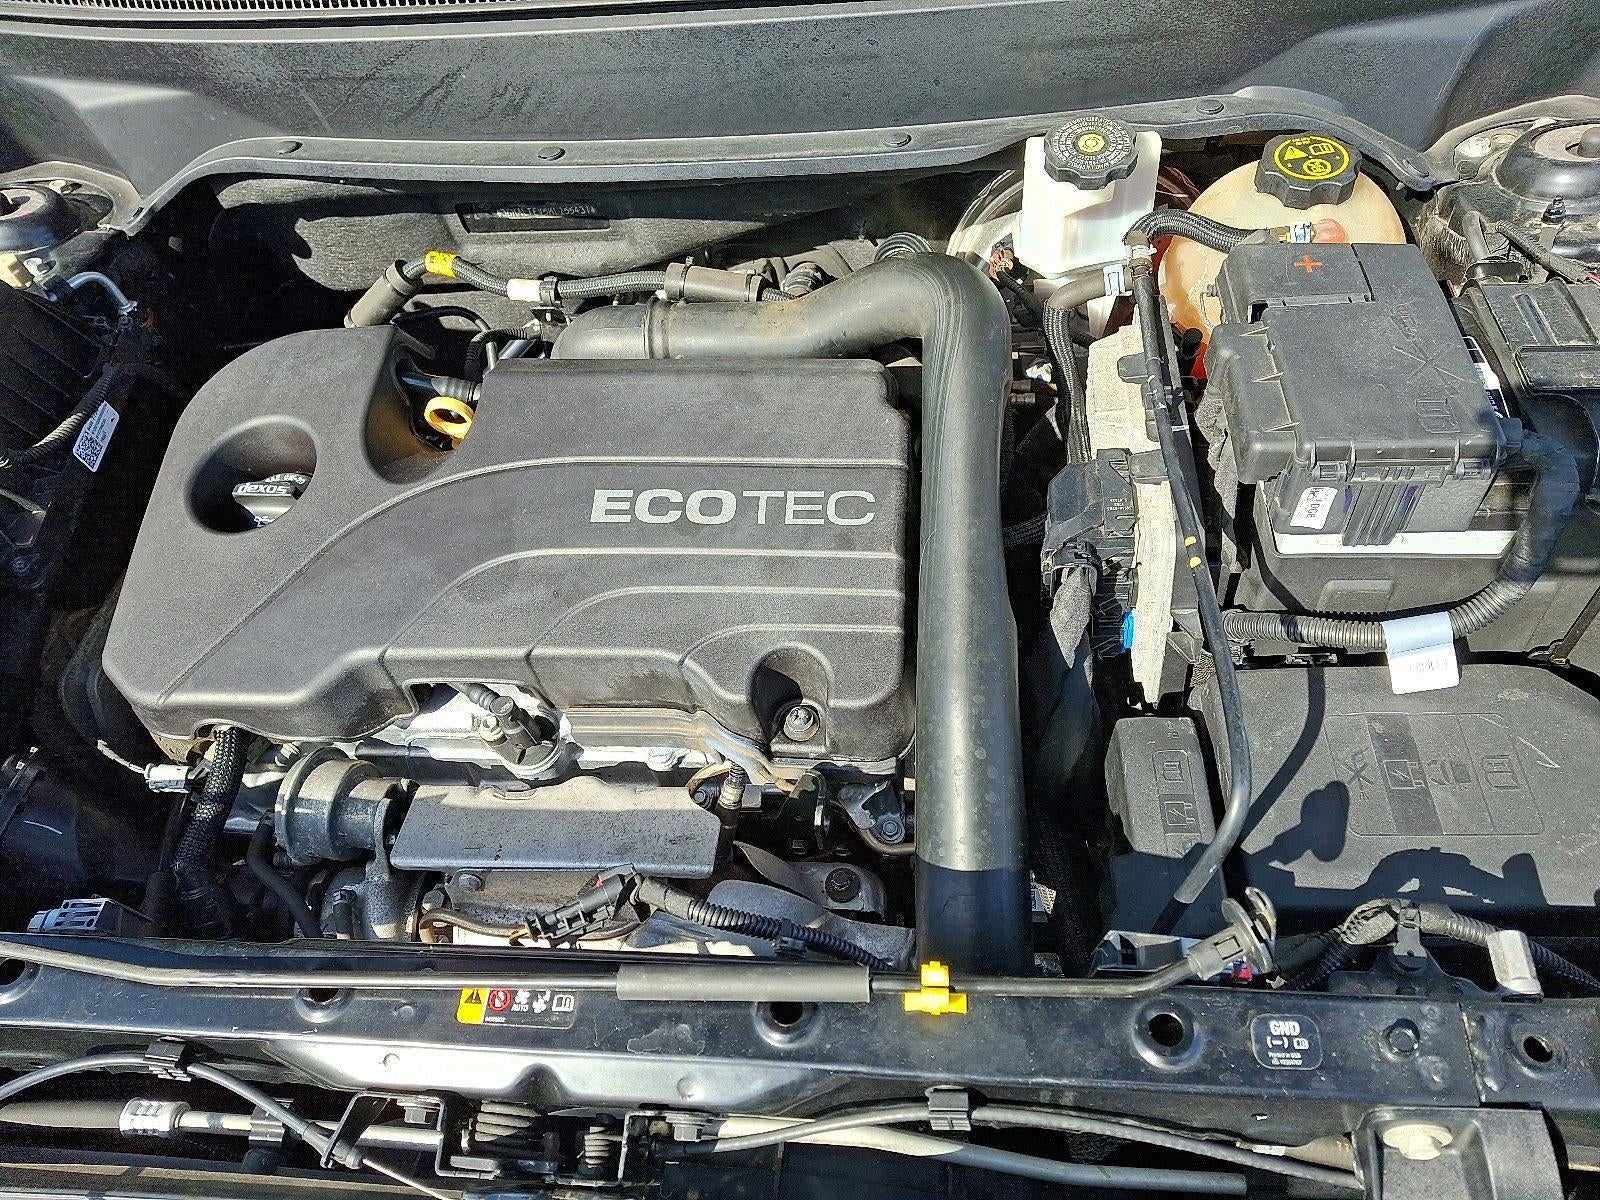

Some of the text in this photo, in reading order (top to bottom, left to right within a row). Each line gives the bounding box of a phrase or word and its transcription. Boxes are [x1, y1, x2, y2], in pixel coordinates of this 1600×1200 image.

[237, 482, 291, 494] dexos
[590, 488, 876, 526] ECOTEC
[511, 1003, 529, 1012] AUTO
[1269, 1020, 1301, 1036] GND
